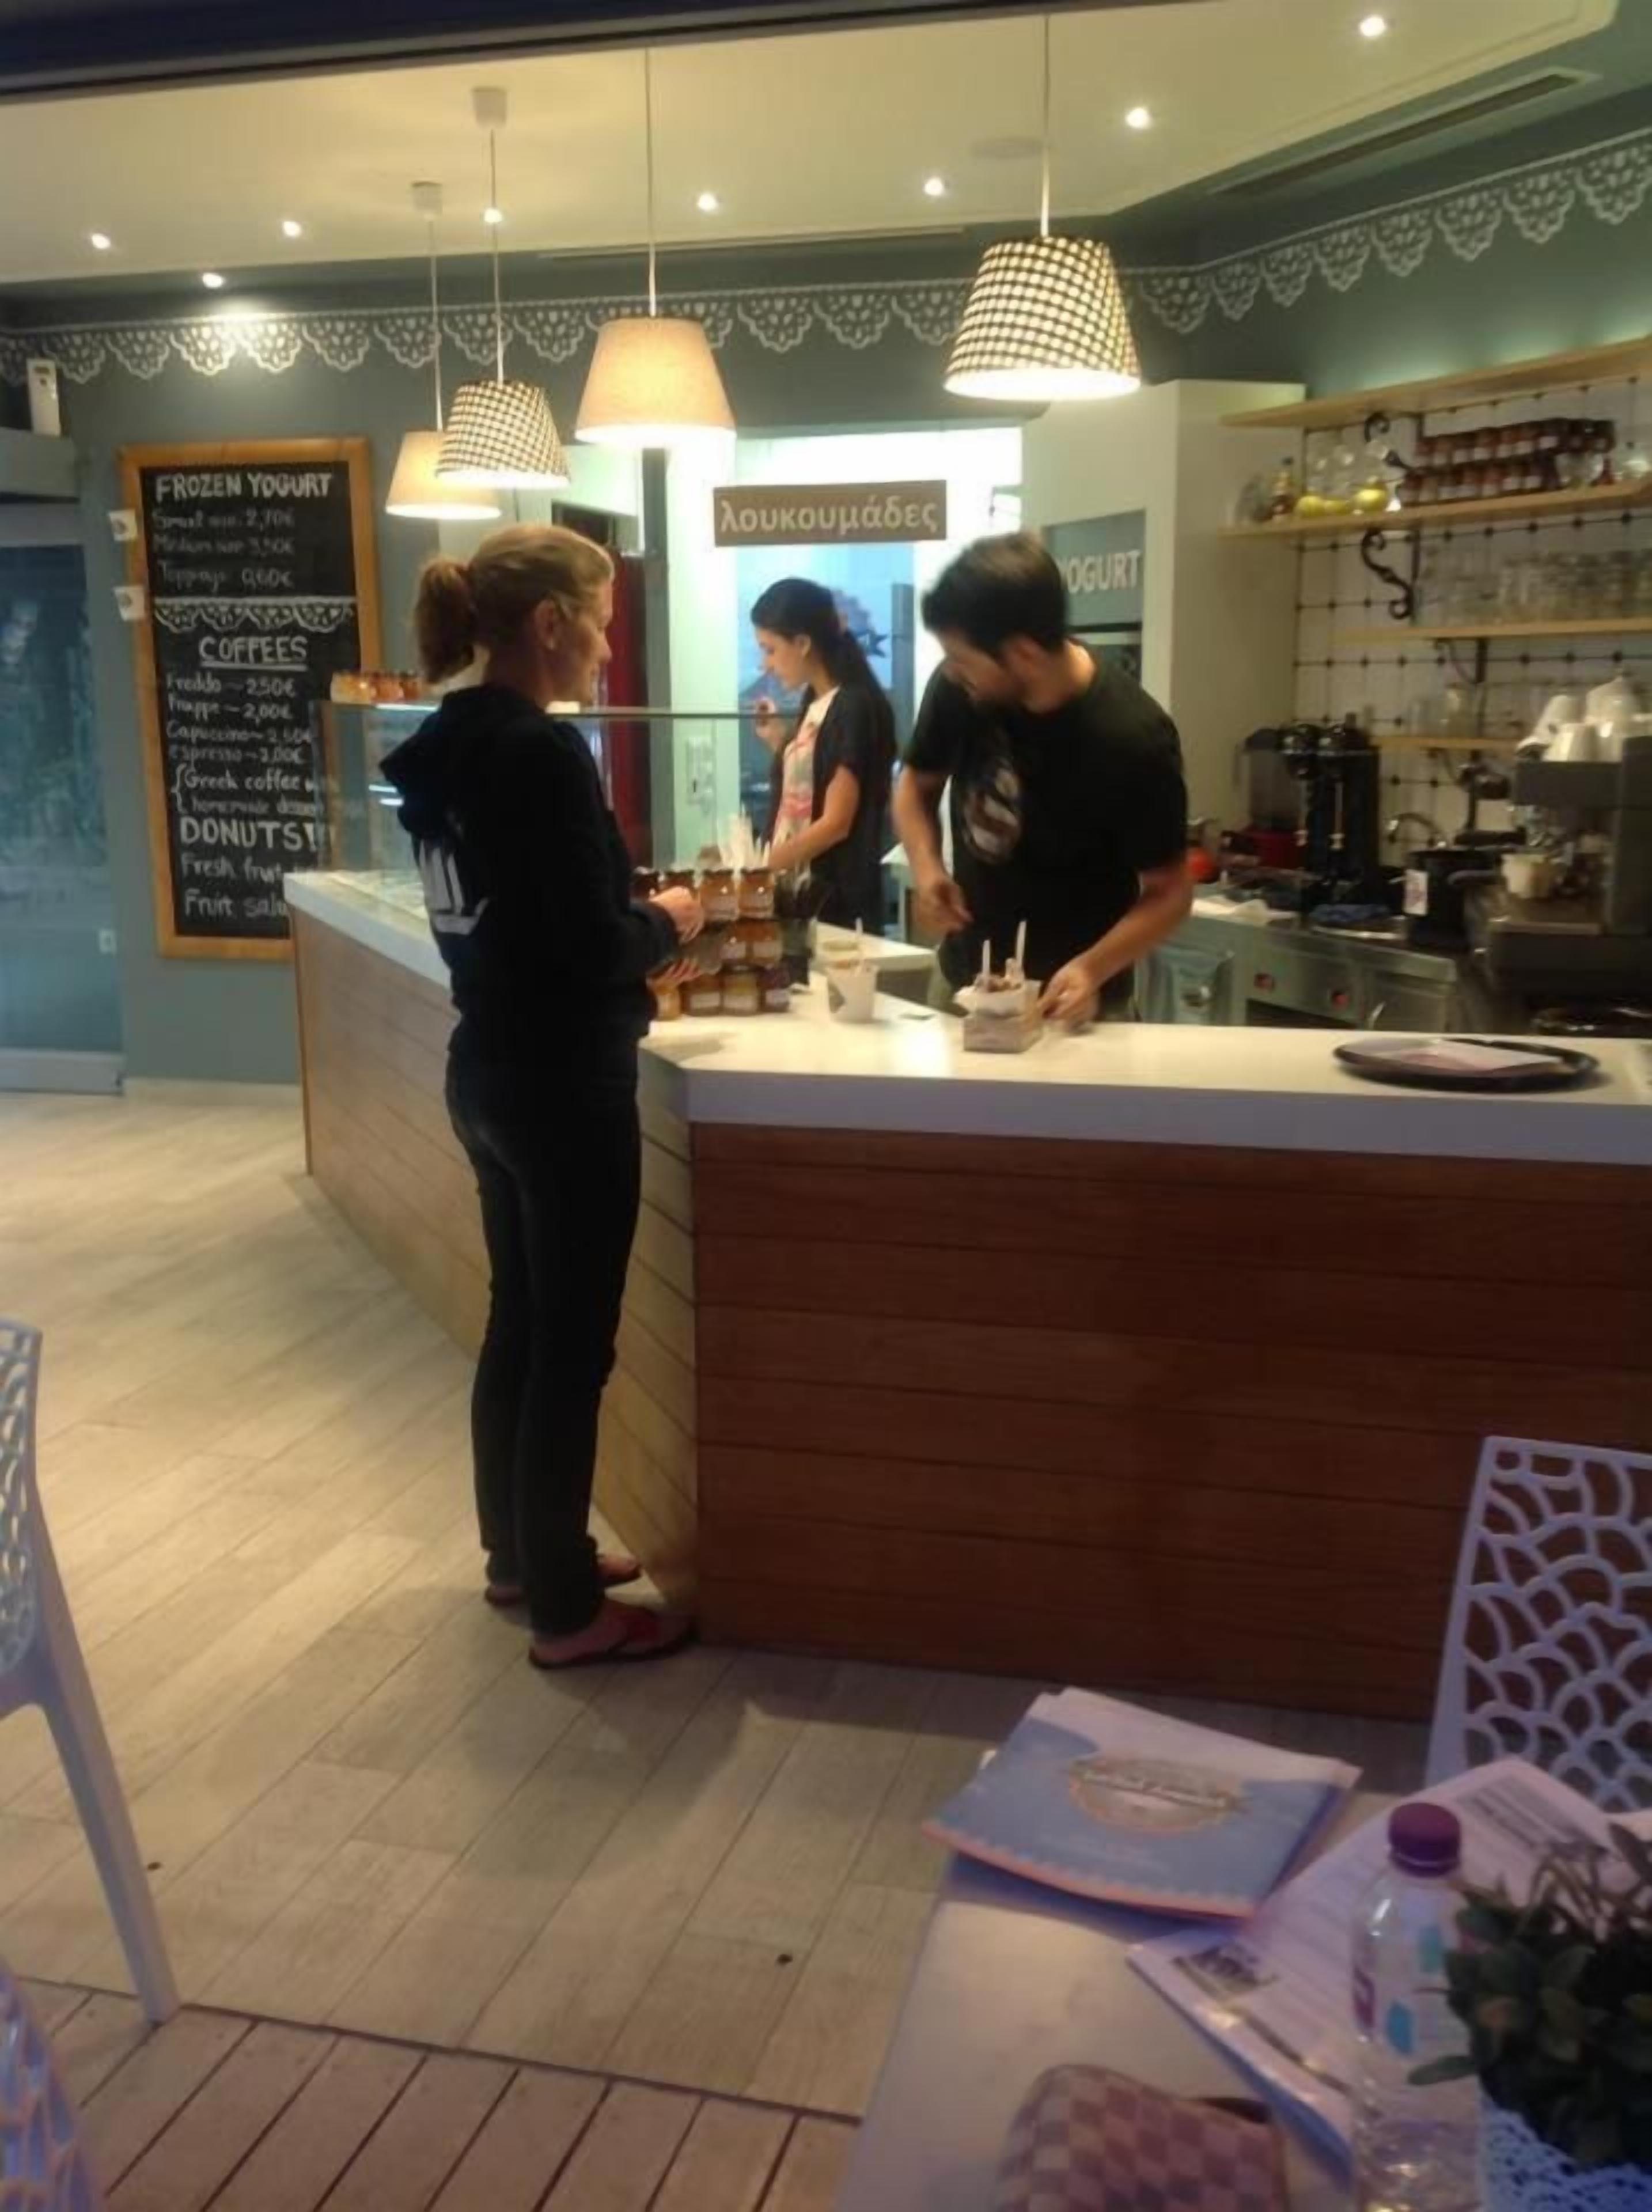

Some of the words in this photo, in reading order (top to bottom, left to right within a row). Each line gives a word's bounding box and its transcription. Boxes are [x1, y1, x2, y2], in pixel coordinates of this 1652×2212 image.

[156, 472, 242, 503] FROZEN
[247, 472, 332, 498] YOGURT
[720, 494, 938, 536] λουκουμάδες
[198, 635, 308, 663] COFFEES
[184, 769, 240, 790] Greek
[244, 767, 300, 791] coffee
[185, 888, 233, 918] Fruit
